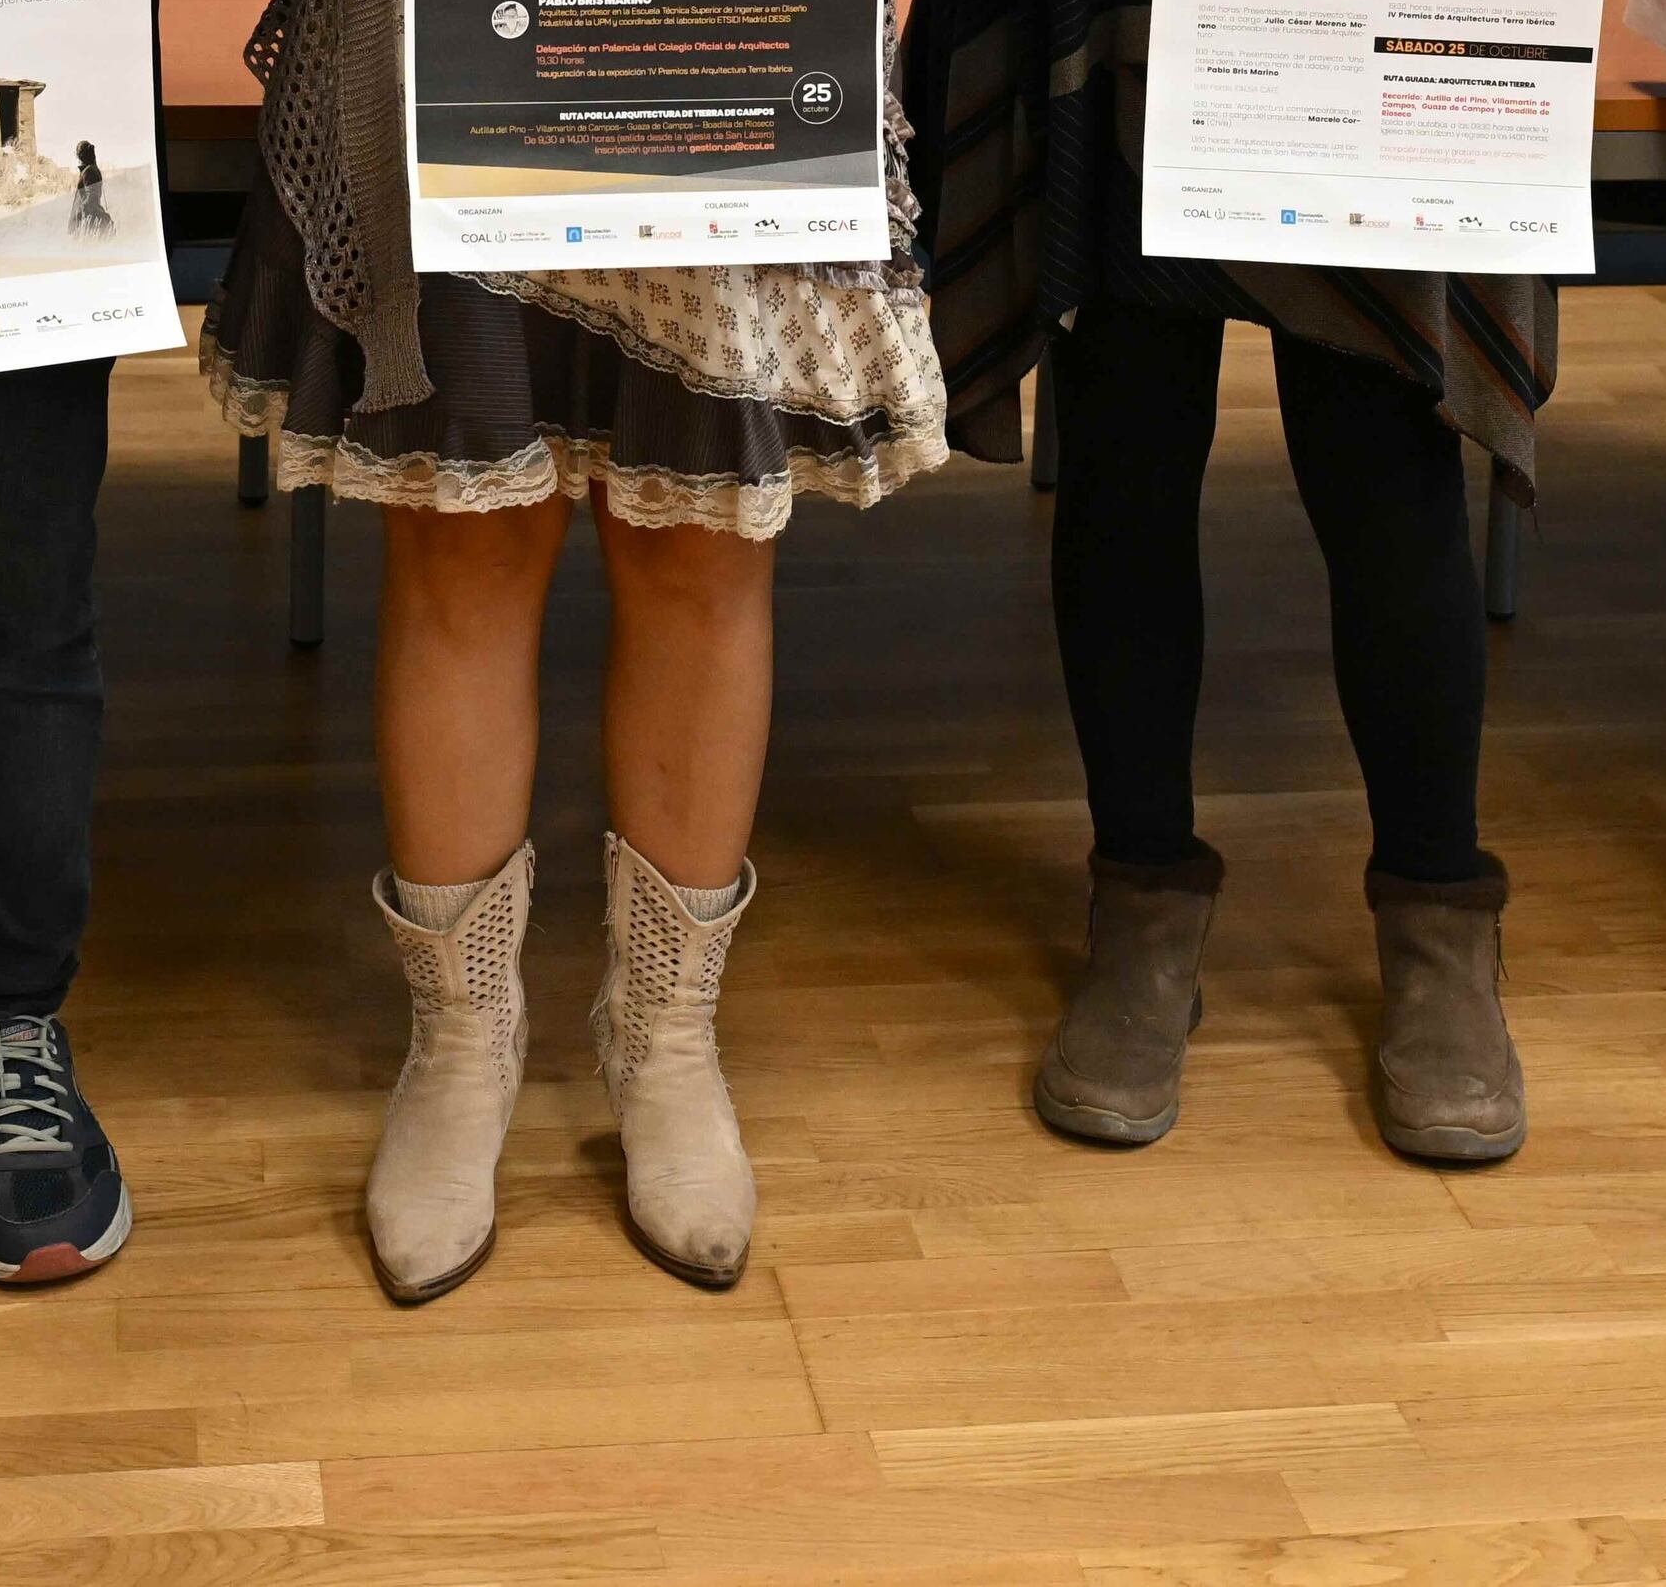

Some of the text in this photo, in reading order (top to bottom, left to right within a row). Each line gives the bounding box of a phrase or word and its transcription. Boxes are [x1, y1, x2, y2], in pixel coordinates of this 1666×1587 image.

[1447, 15, 1499, 23] Arquitectura
[1386, 39, 1549, 59] SÁBADO 25 DE OCTUBRE
[1438, 78, 1497, 86] ARQUITECTURA
[803, 83, 831, 102] 25
[560, 112, 584, 120] RUTA
[583, 112, 604, 120] POR
[615, 110, 682, 120] ARQUITECTURA
[693, 109, 725, 117] TIERRA
[736, 108, 774, 116] CAMPOS
[1184, 209, 1211, 218] COAL
[461, 234, 491, 243] COAL
